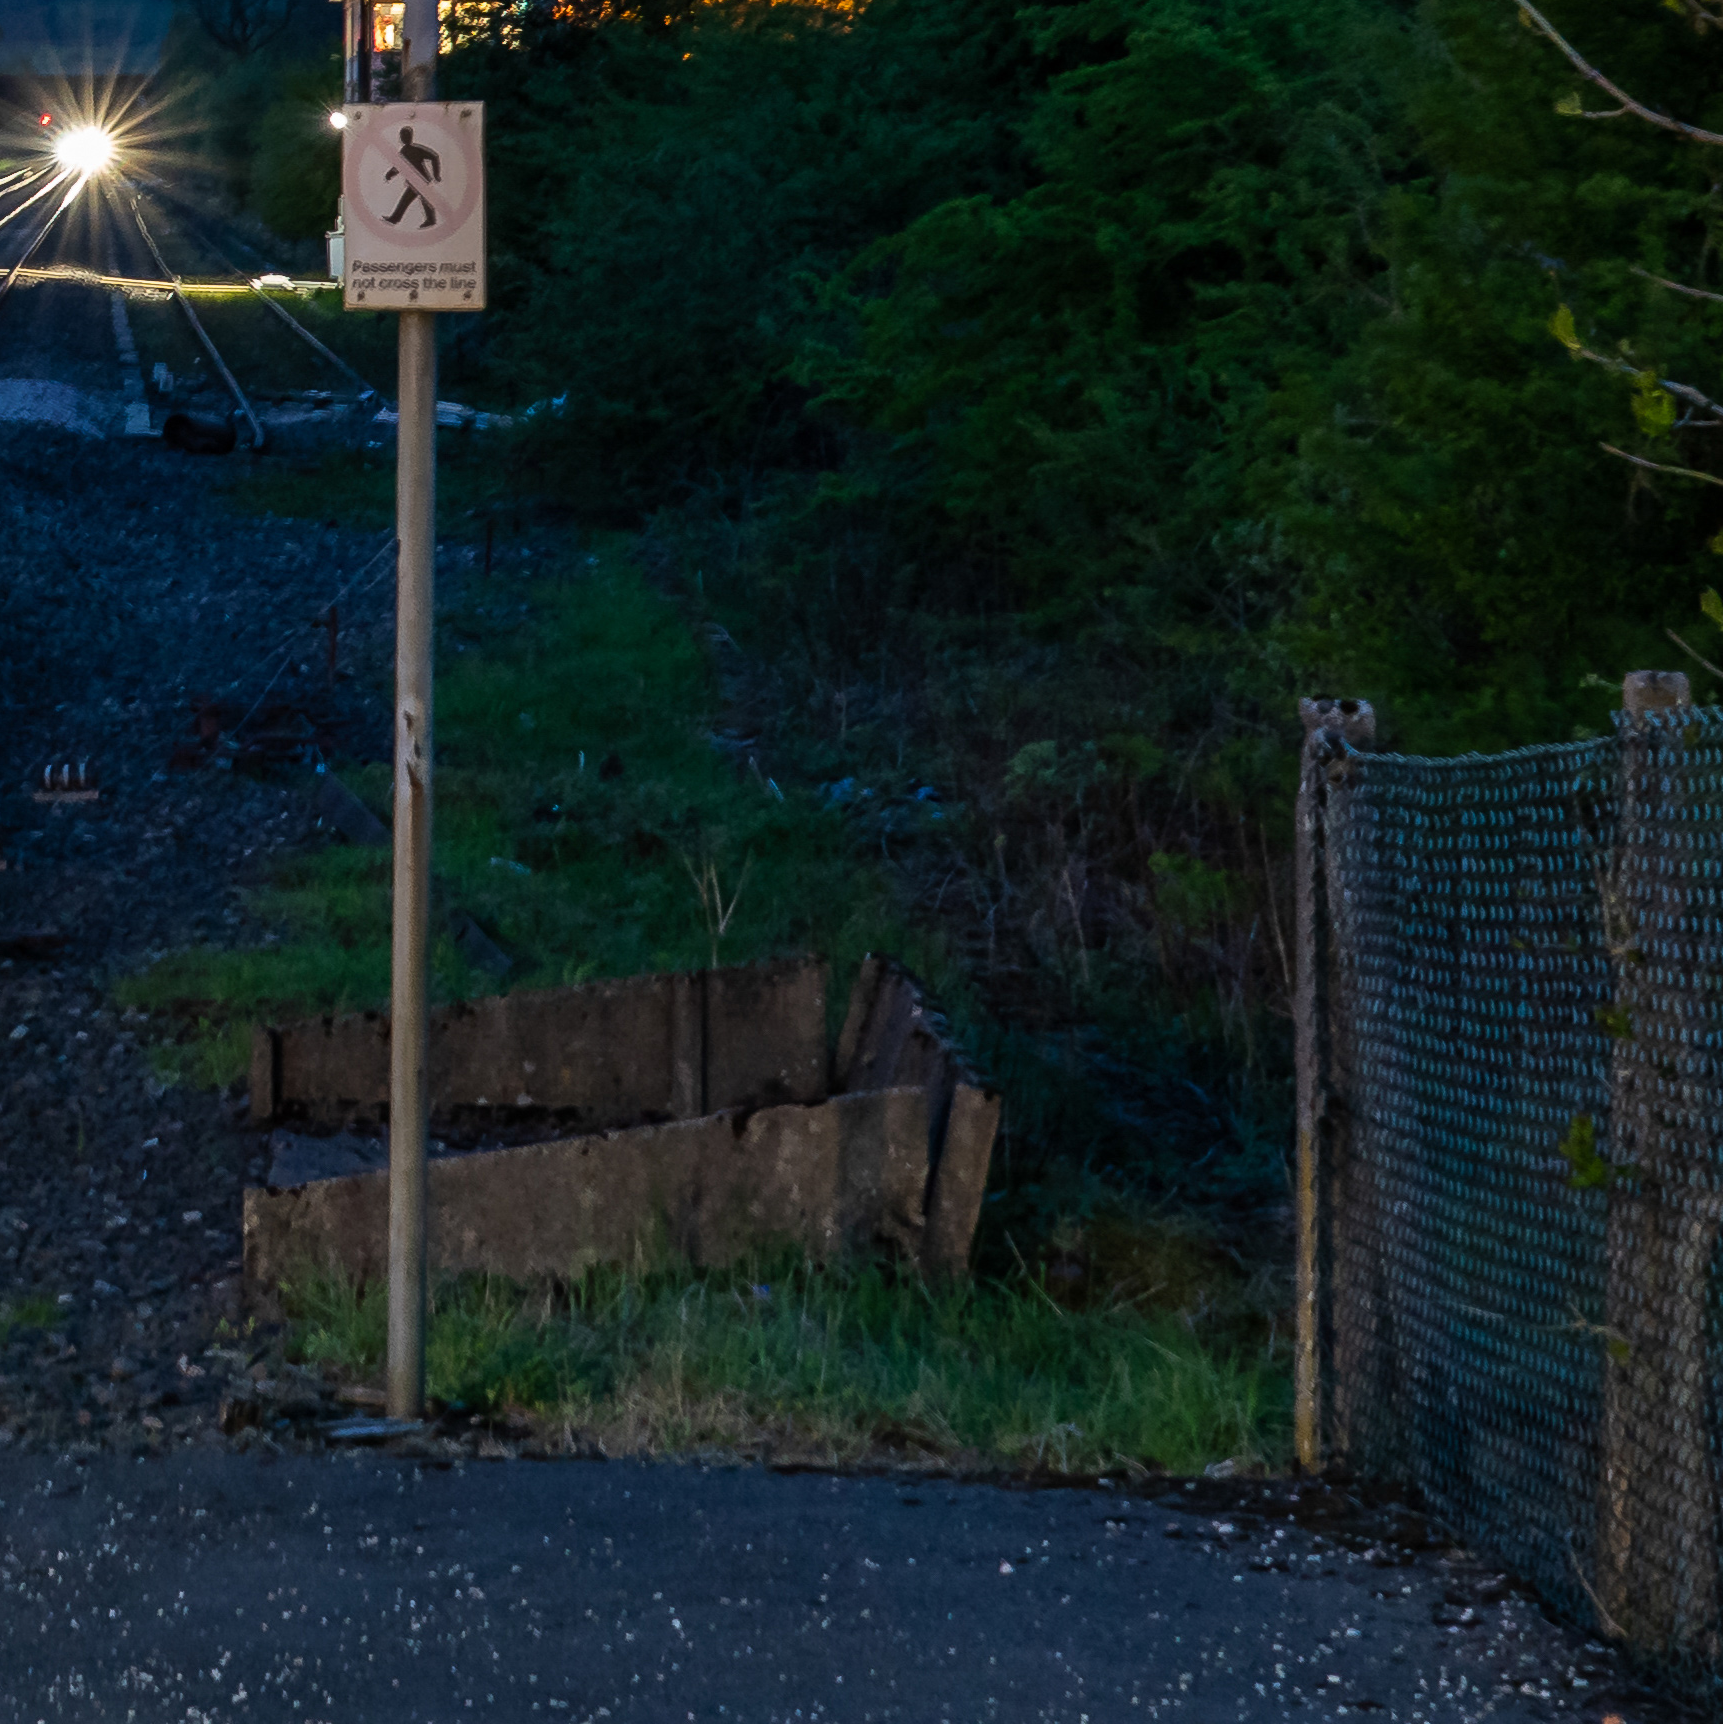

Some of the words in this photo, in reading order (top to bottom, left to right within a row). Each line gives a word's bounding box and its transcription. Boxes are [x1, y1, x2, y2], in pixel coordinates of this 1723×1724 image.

[352, 260, 437, 275] Passengers
[439, 262, 477, 273] must
[352, 277, 375, 289] not
[378, 278, 419, 289] cross
[423, 277, 447, 289] the
[450, 277, 477, 289] line
